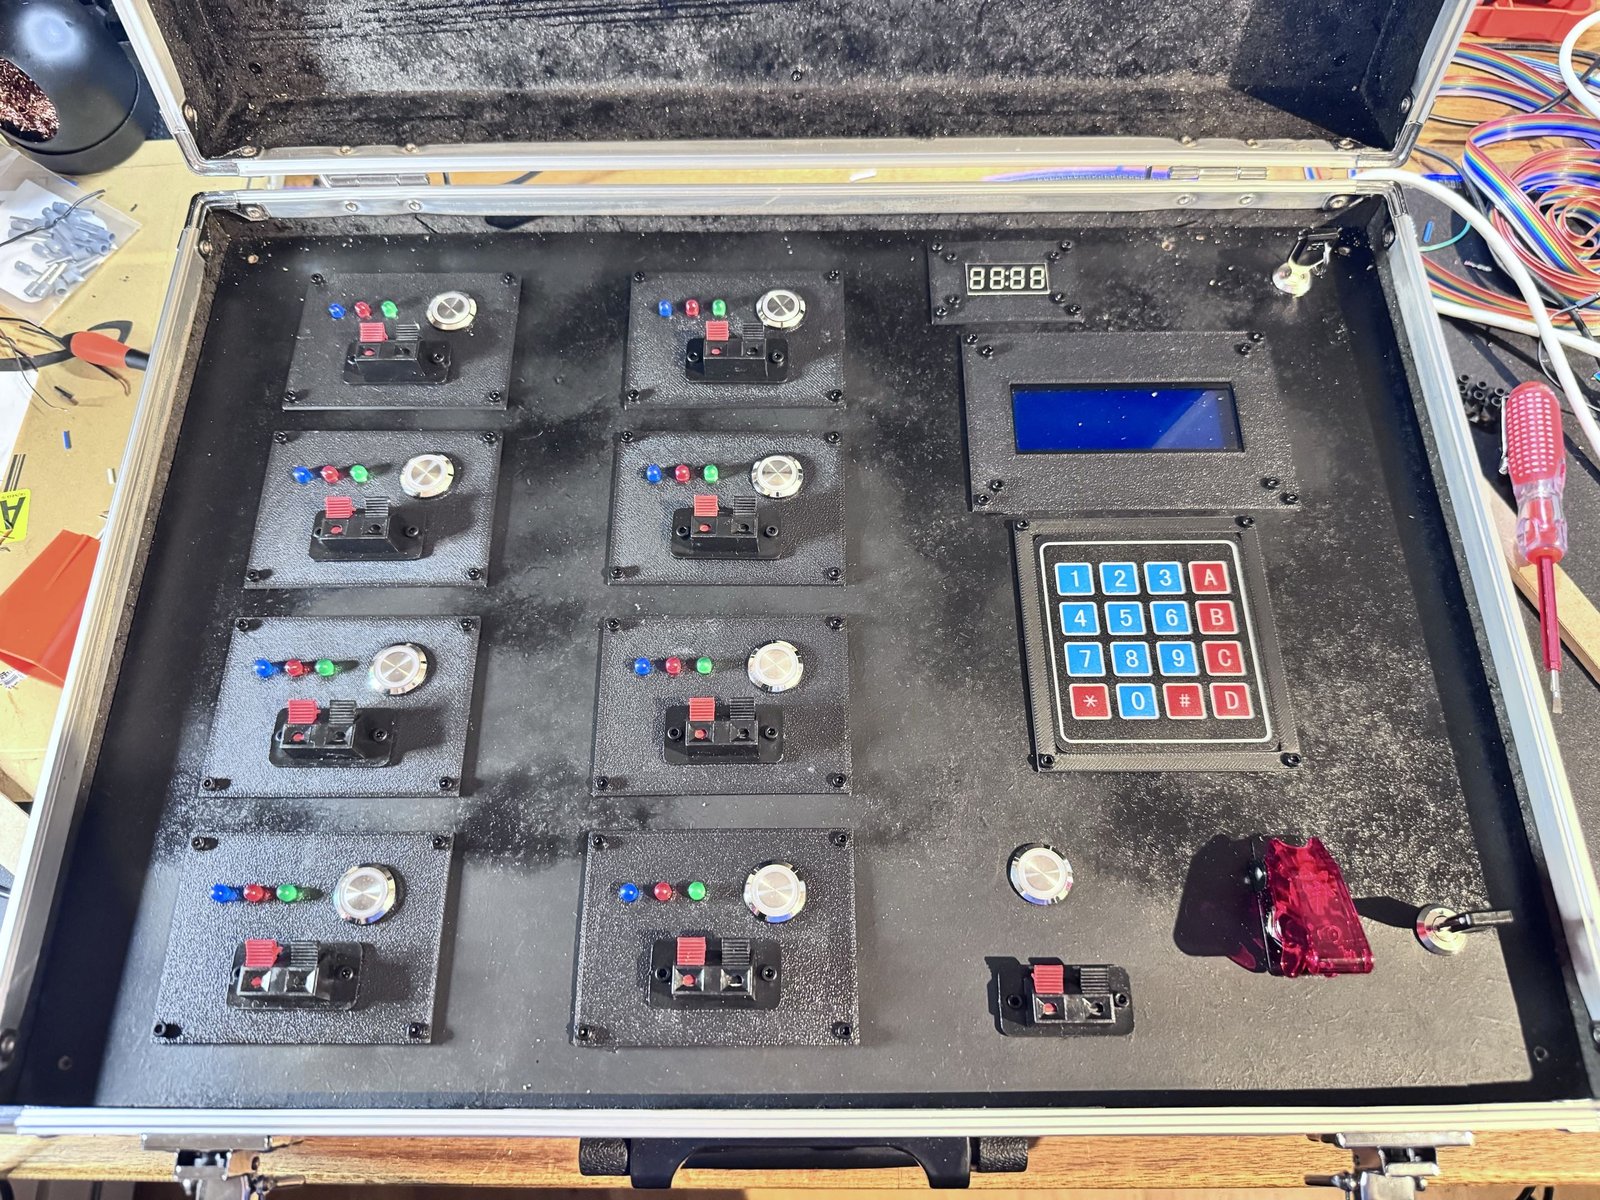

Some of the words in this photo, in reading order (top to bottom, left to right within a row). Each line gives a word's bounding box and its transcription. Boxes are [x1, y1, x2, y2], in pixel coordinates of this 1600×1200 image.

[969, 267, 1045, 289] 88:88
[1070, 570, 1079, 587] 1
[1114, 570, 1127, 587] 2
[1159, 569, 1172, 586] 3
[1204, 569, 1218, 586] A
[1074, 610, 1087, 627] 4
[1120, 609, 1133, 627] 5
[1166, 608, 1178, 626] 6
[1211, 608, 1224, 626] B
[1080, 651, 1090, 667] 7
[1126, 650, 1139, 667] 8
[1173, 650, 1185, 667] 9
[1218, 649, 1231, 667] C
[1132, 692, 1144, 710] 0
[1225, 691, 1239, 709] D
